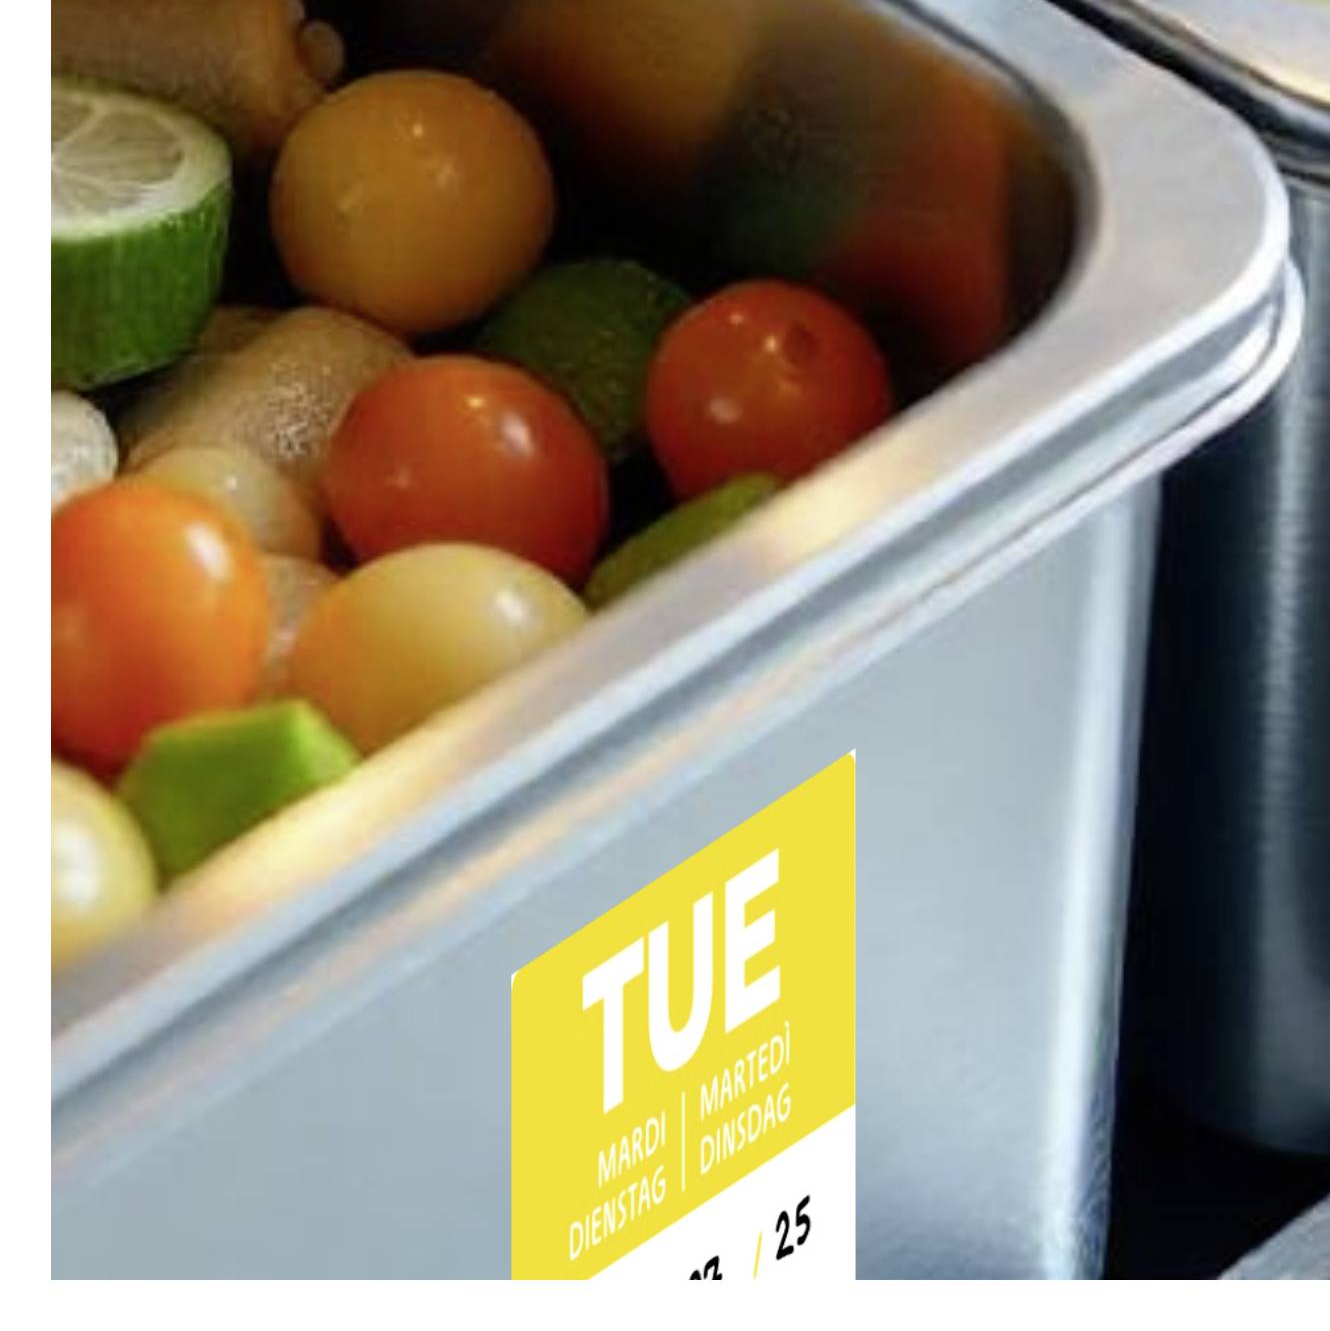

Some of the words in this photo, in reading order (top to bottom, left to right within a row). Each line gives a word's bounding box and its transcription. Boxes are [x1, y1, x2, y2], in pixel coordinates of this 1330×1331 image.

[582, 848, 781, 1114] TUE
[700, 1021, 791, 1122] MARTEDÌ
[598, 1110, 666, 1188] MARDI
[700, 1082, 792, 1175] DINSDAG
[569, 1165, 667, 1261] DIENSTAG
[775, 1194, 812, 1260] 25
